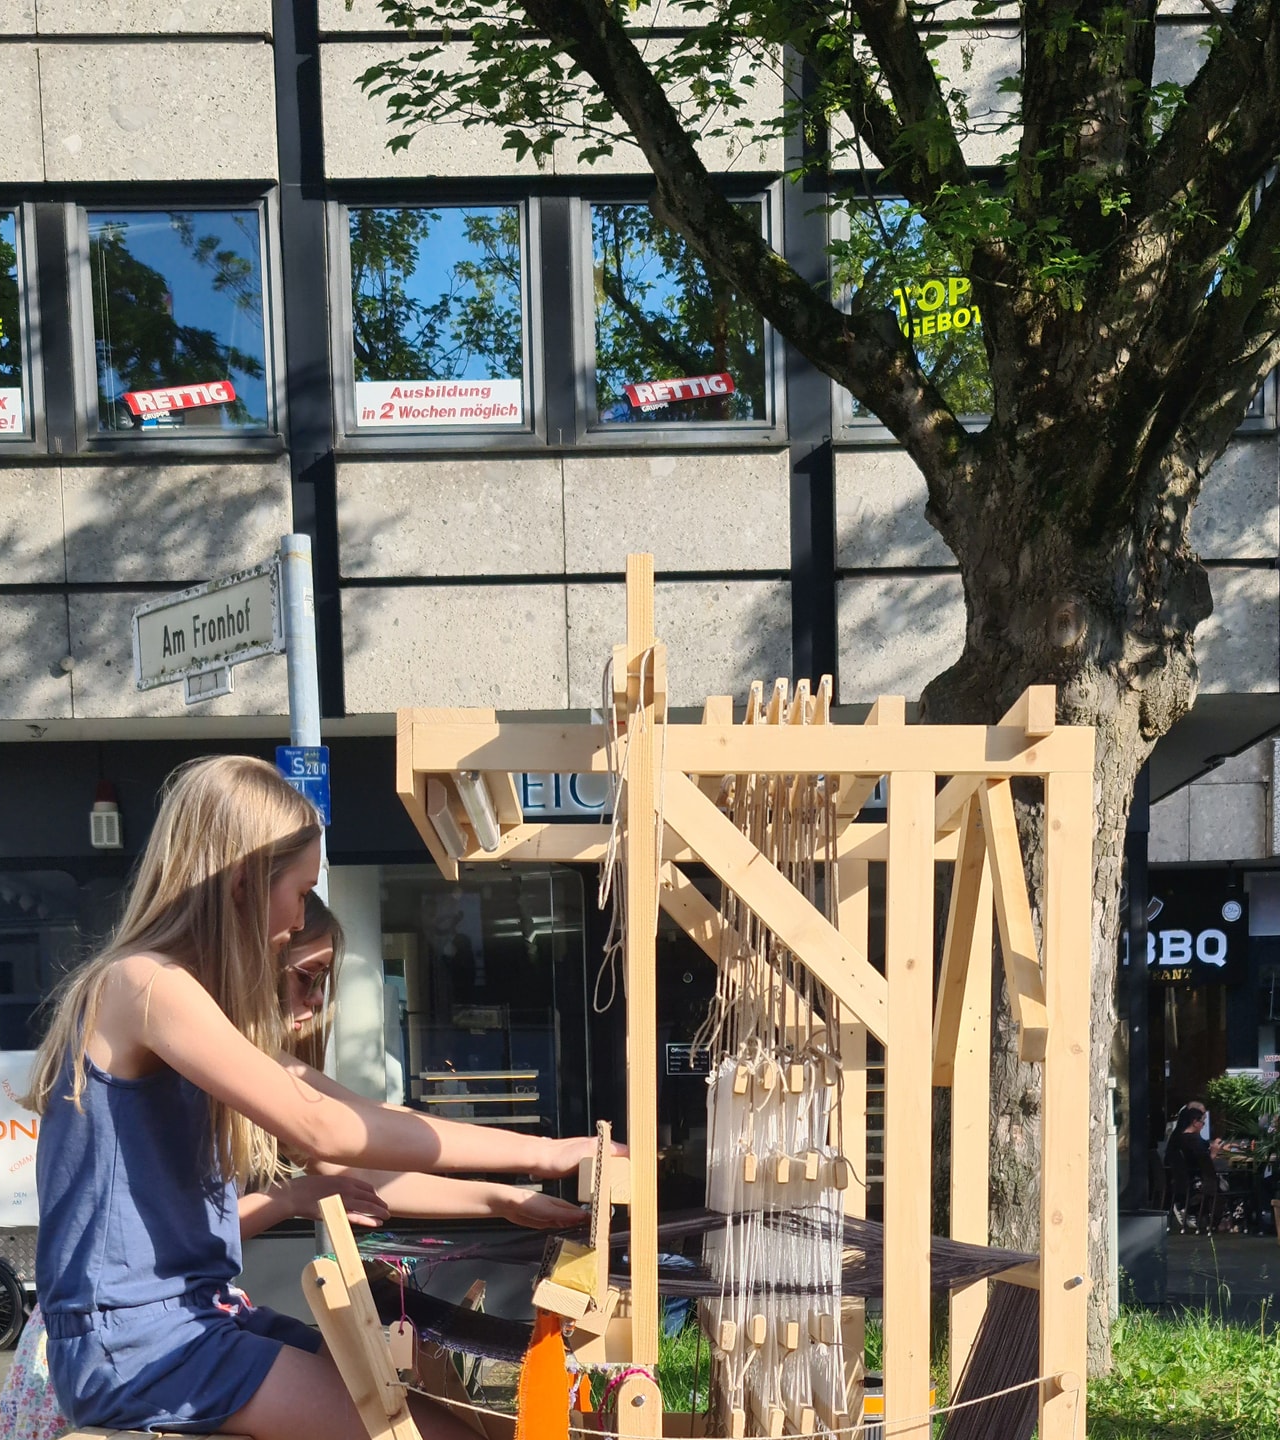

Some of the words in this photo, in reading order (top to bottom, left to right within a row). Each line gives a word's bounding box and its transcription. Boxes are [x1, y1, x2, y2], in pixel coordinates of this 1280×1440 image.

[137, 382, 228, 413] RETTIG
[390, 385, 491, 400] Ausbildung
[636, 376, 726, 404] RETTIG
[362, 407, 375, 420] in
[380, 403, 394, 420] 2
[399, 405, 457, 419] Wochen
[459, 403, 518, 421] möglich
[163, 625, 185, 658] Am
[192, 597, 250, 649] Fronhof
[8, 1155, 34, 1173] KOMM
